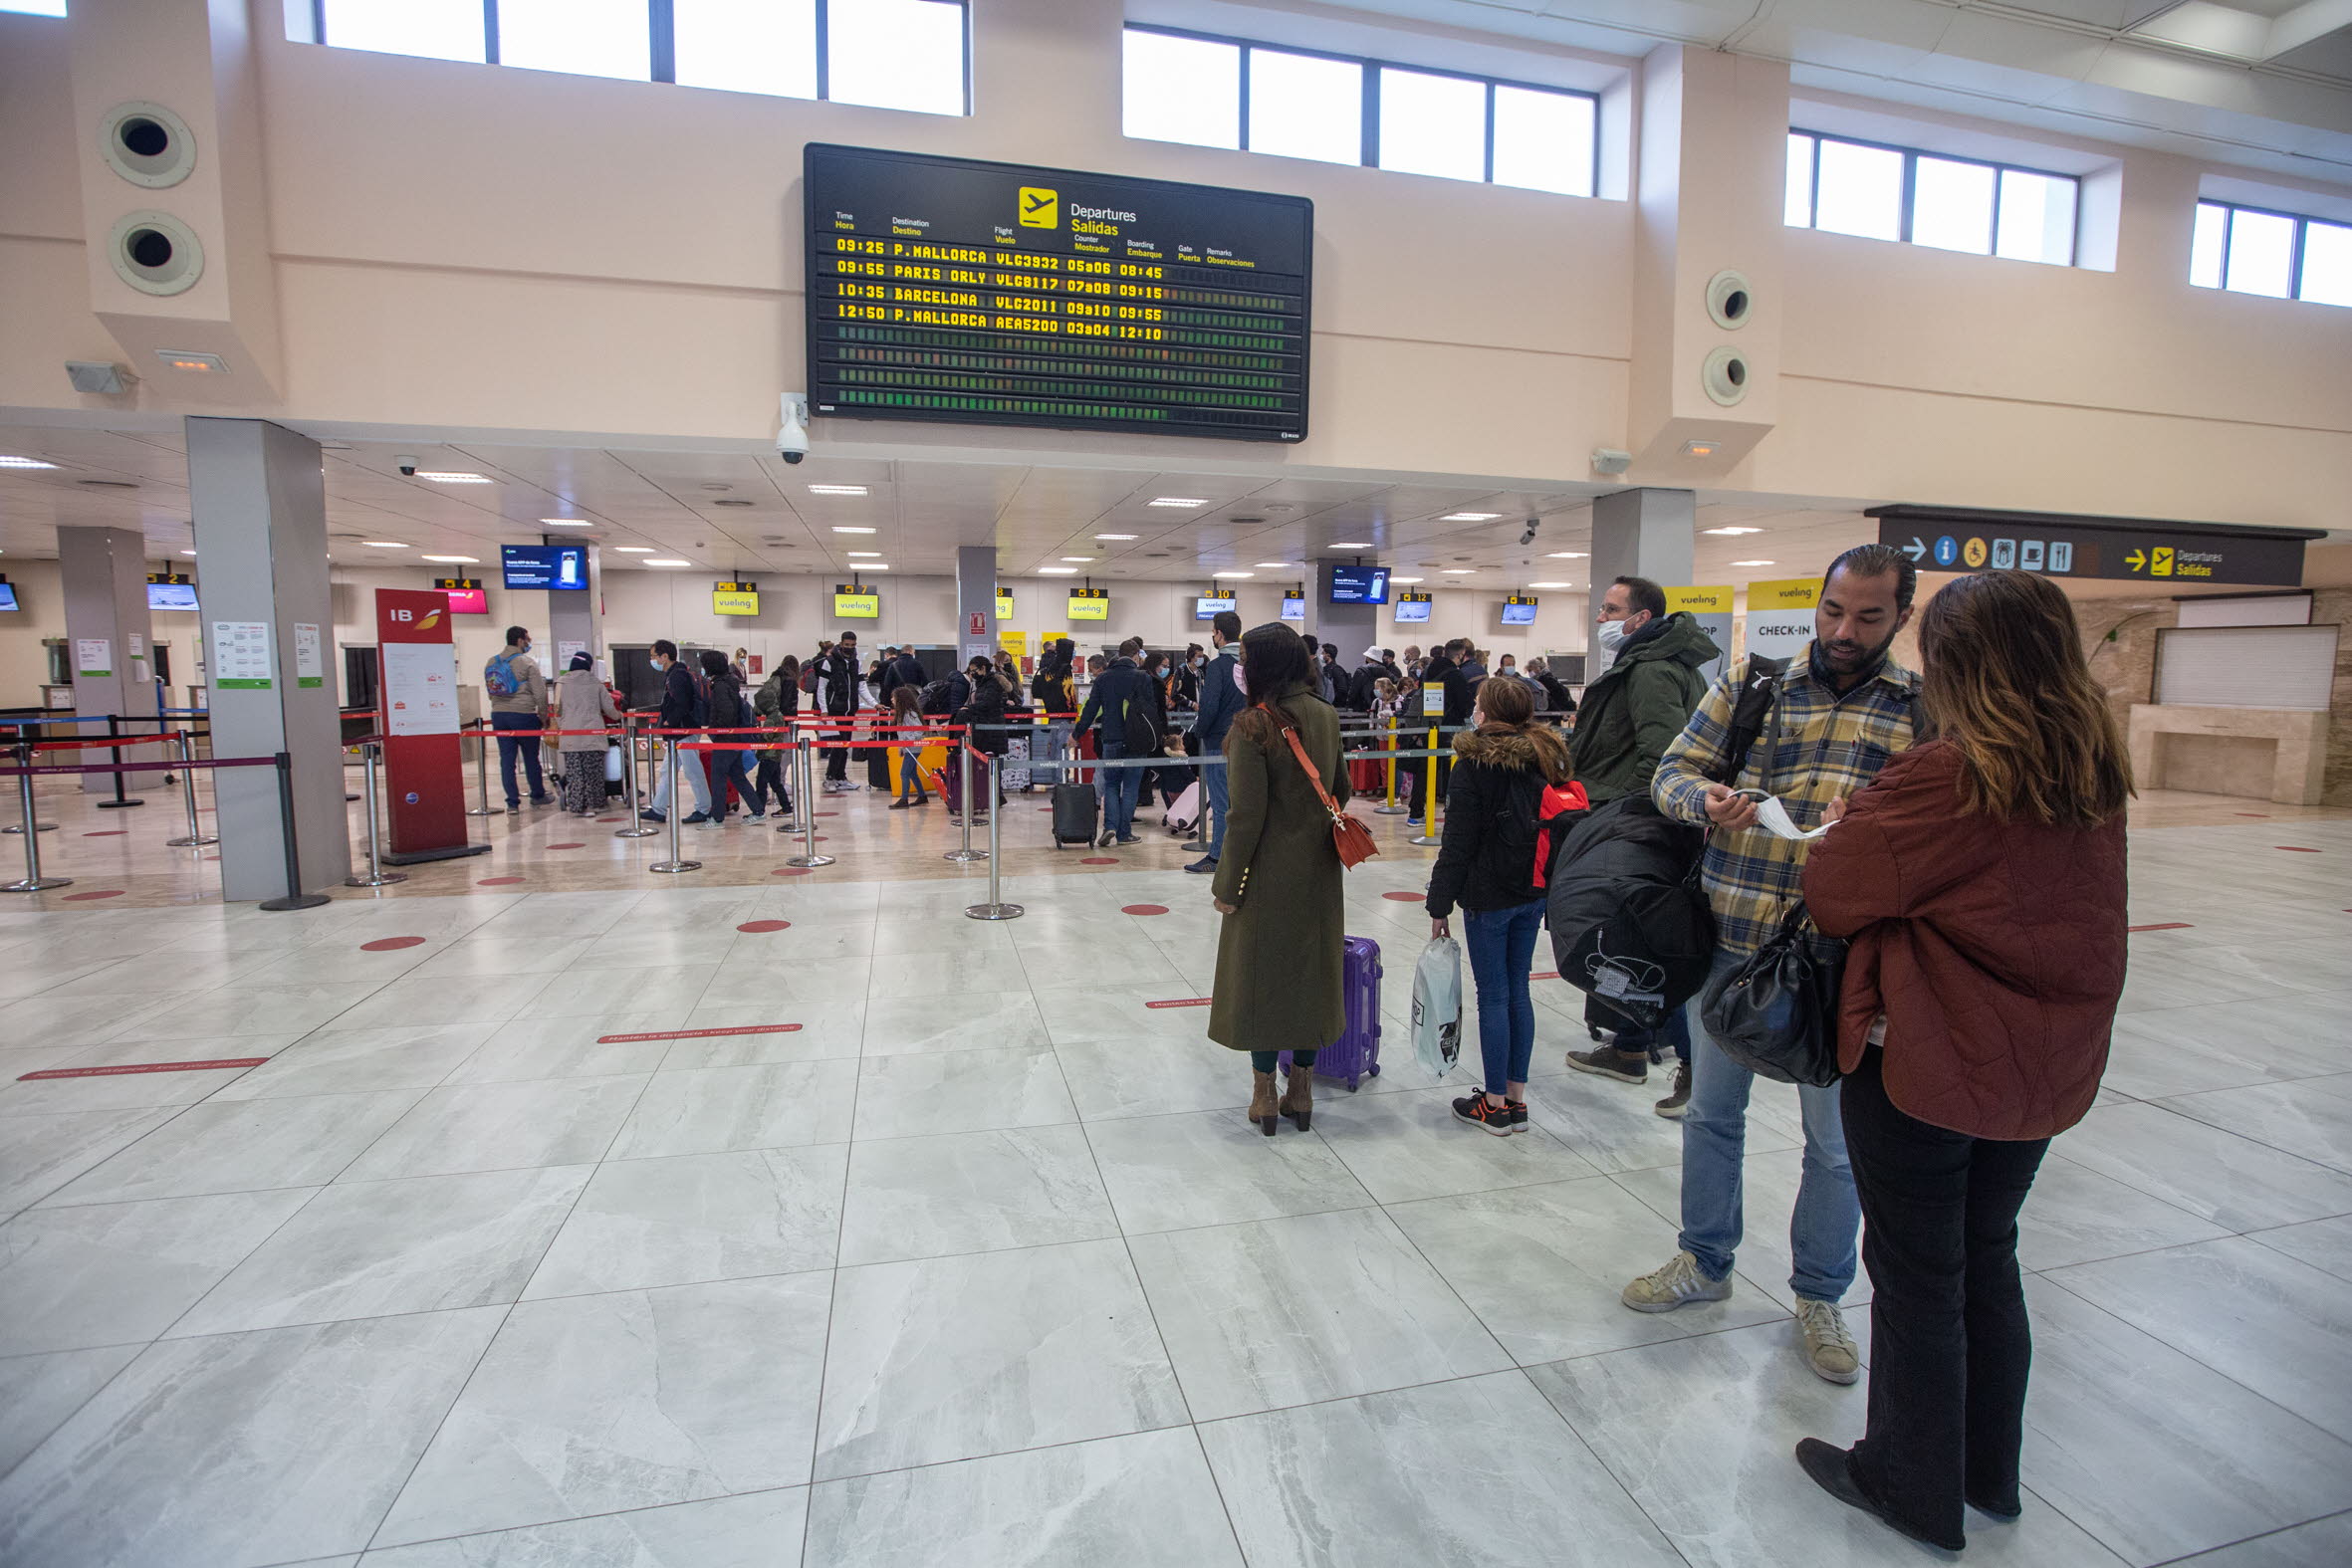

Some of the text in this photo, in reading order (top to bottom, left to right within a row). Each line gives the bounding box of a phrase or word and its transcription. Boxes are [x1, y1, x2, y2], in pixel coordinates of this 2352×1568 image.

[835, 211, 853, 220] Time
[1070, 203, 1136, 222] Departures
[834, 220, 854, 230] Hora
[892, 217, 929, 227] Destination
[892, 226, 921, 236] Destino
[995, 226, 1013, 237] Flight
[1071, 220, 1118, 236] Salidas
[995, 235, 1016, 245] Vuelo
[1074, 234, 1098, 243] Counter
[1074, 243, 1109, 254] Mostrador
[1127, 239, 1154, 250] Boarding
[1127, 248, 1162, 260] Embarque
[1178, 253, 1201, 263] Puerta
[1207, 248, 1232, 258] Remarks
[836, 238, 1162, 279] 09:25 P.MALLORCA VLG3932 05a06 08:45
[1207, 256, 1255, 268] Observaciones
[837, 260, 1162, 299] 09:55 PARIS ORLY VLG8117 07a08 09:15
[837, 283, 884, 299] 10:35
[894, 287, 978, 307] BARCELONA
[996, 296, 1057, 313] VLG2011
[1119, 306, 1162, 321] 09:55
[837, 304, 1161, 340] 12:50 P.MALLORCA AEA5200 03a04 12:10
[2177, 550, 2223, 562] Departures
[2177, 563, 2212, 576] Salidas
[168, 573, 178, 583] 2
[462, 578, 472, 588] 4
[997, 587, 1004, 596] 8
[1218, 590, 1230, 599] 10
[1779, 588, 1812, 599] vueling
[719, 599, 751, 609] vueling
[1681, 595, 1718, 605] vueling
[840, 601, 871, 611] vueling
[1073, 604, 1101, 613] vueling
[390, 609, 413, 622] IB
[1705, 626, 1718, 635] OP
[1759, 625, 1810, 636] CHECK-IN
